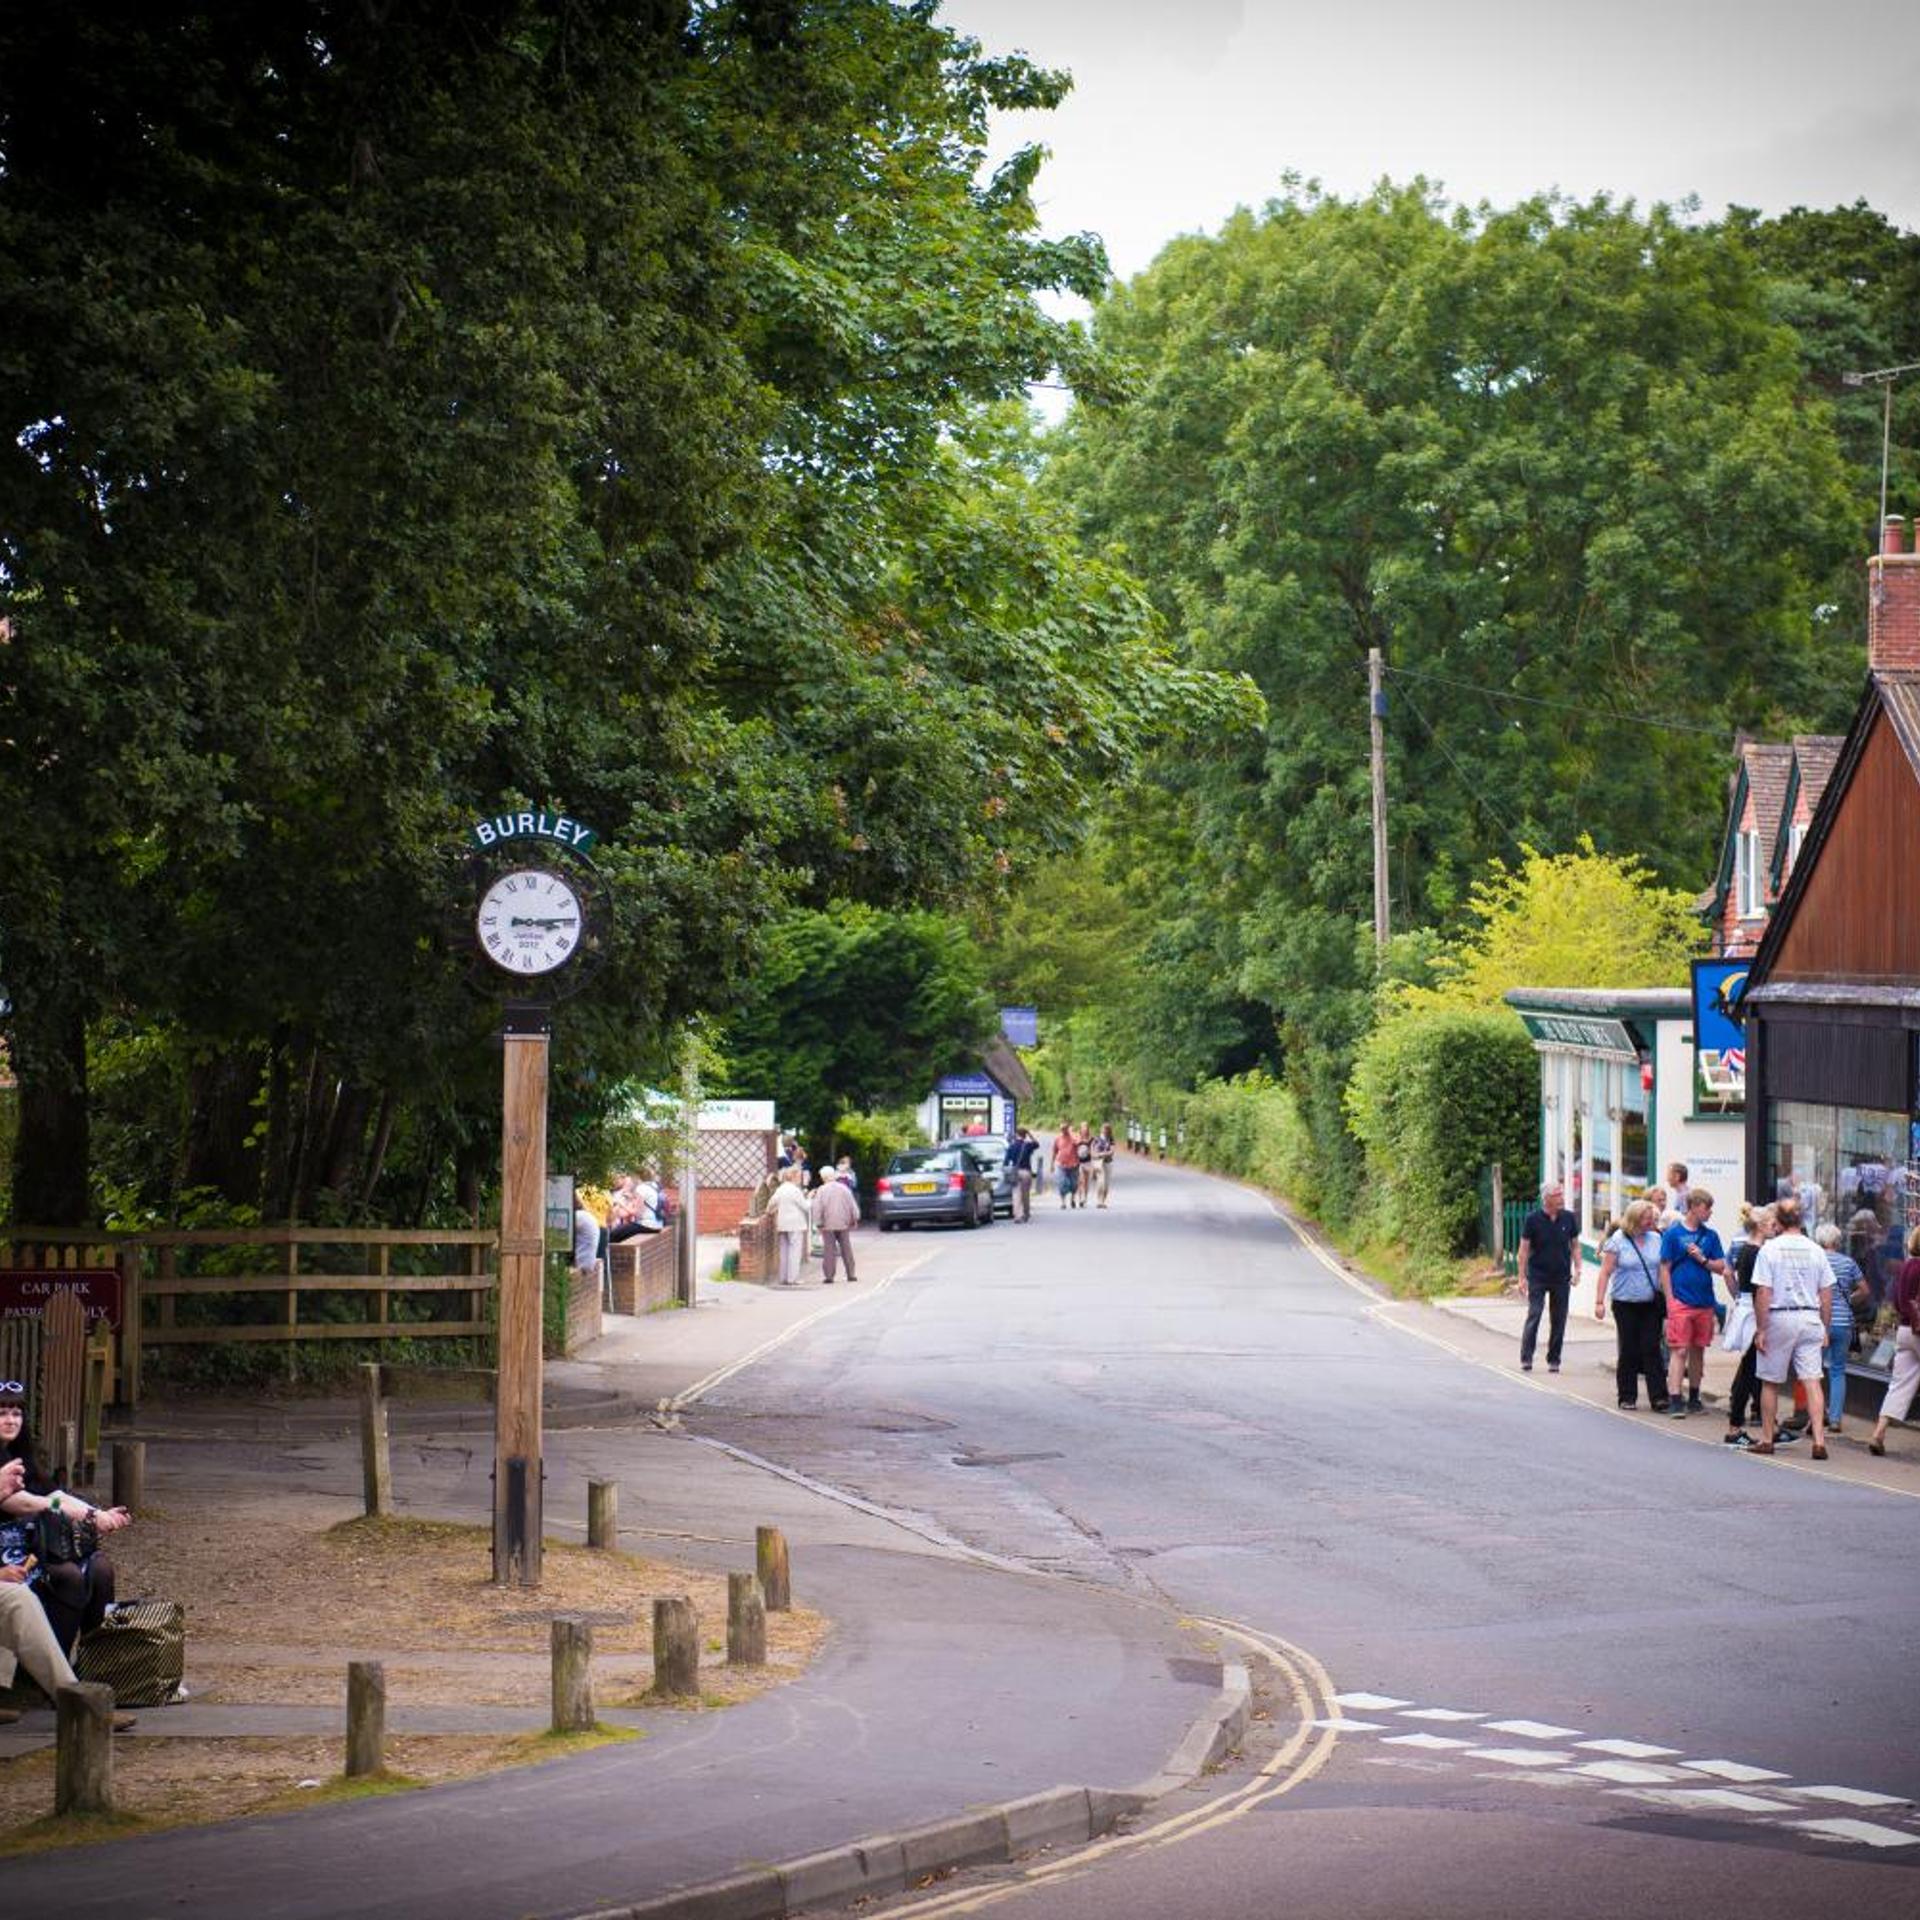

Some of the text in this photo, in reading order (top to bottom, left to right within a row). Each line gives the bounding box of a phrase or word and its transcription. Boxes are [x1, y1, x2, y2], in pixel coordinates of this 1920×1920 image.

[475, 813, 589, 845] BURLEY
[505, 880, 517, 893] XI
[524, 876, 537, 889] XII
[547, 884, 554, 894] I
[489, 898, 502, 907] X
[557, 899, 571, 908] II
[483, 916, 497, 926] IX
[518, 941, 540, 949] 2012
[545, 952, 553, 965] V
[21, 1282, 50, 1295] CAR
